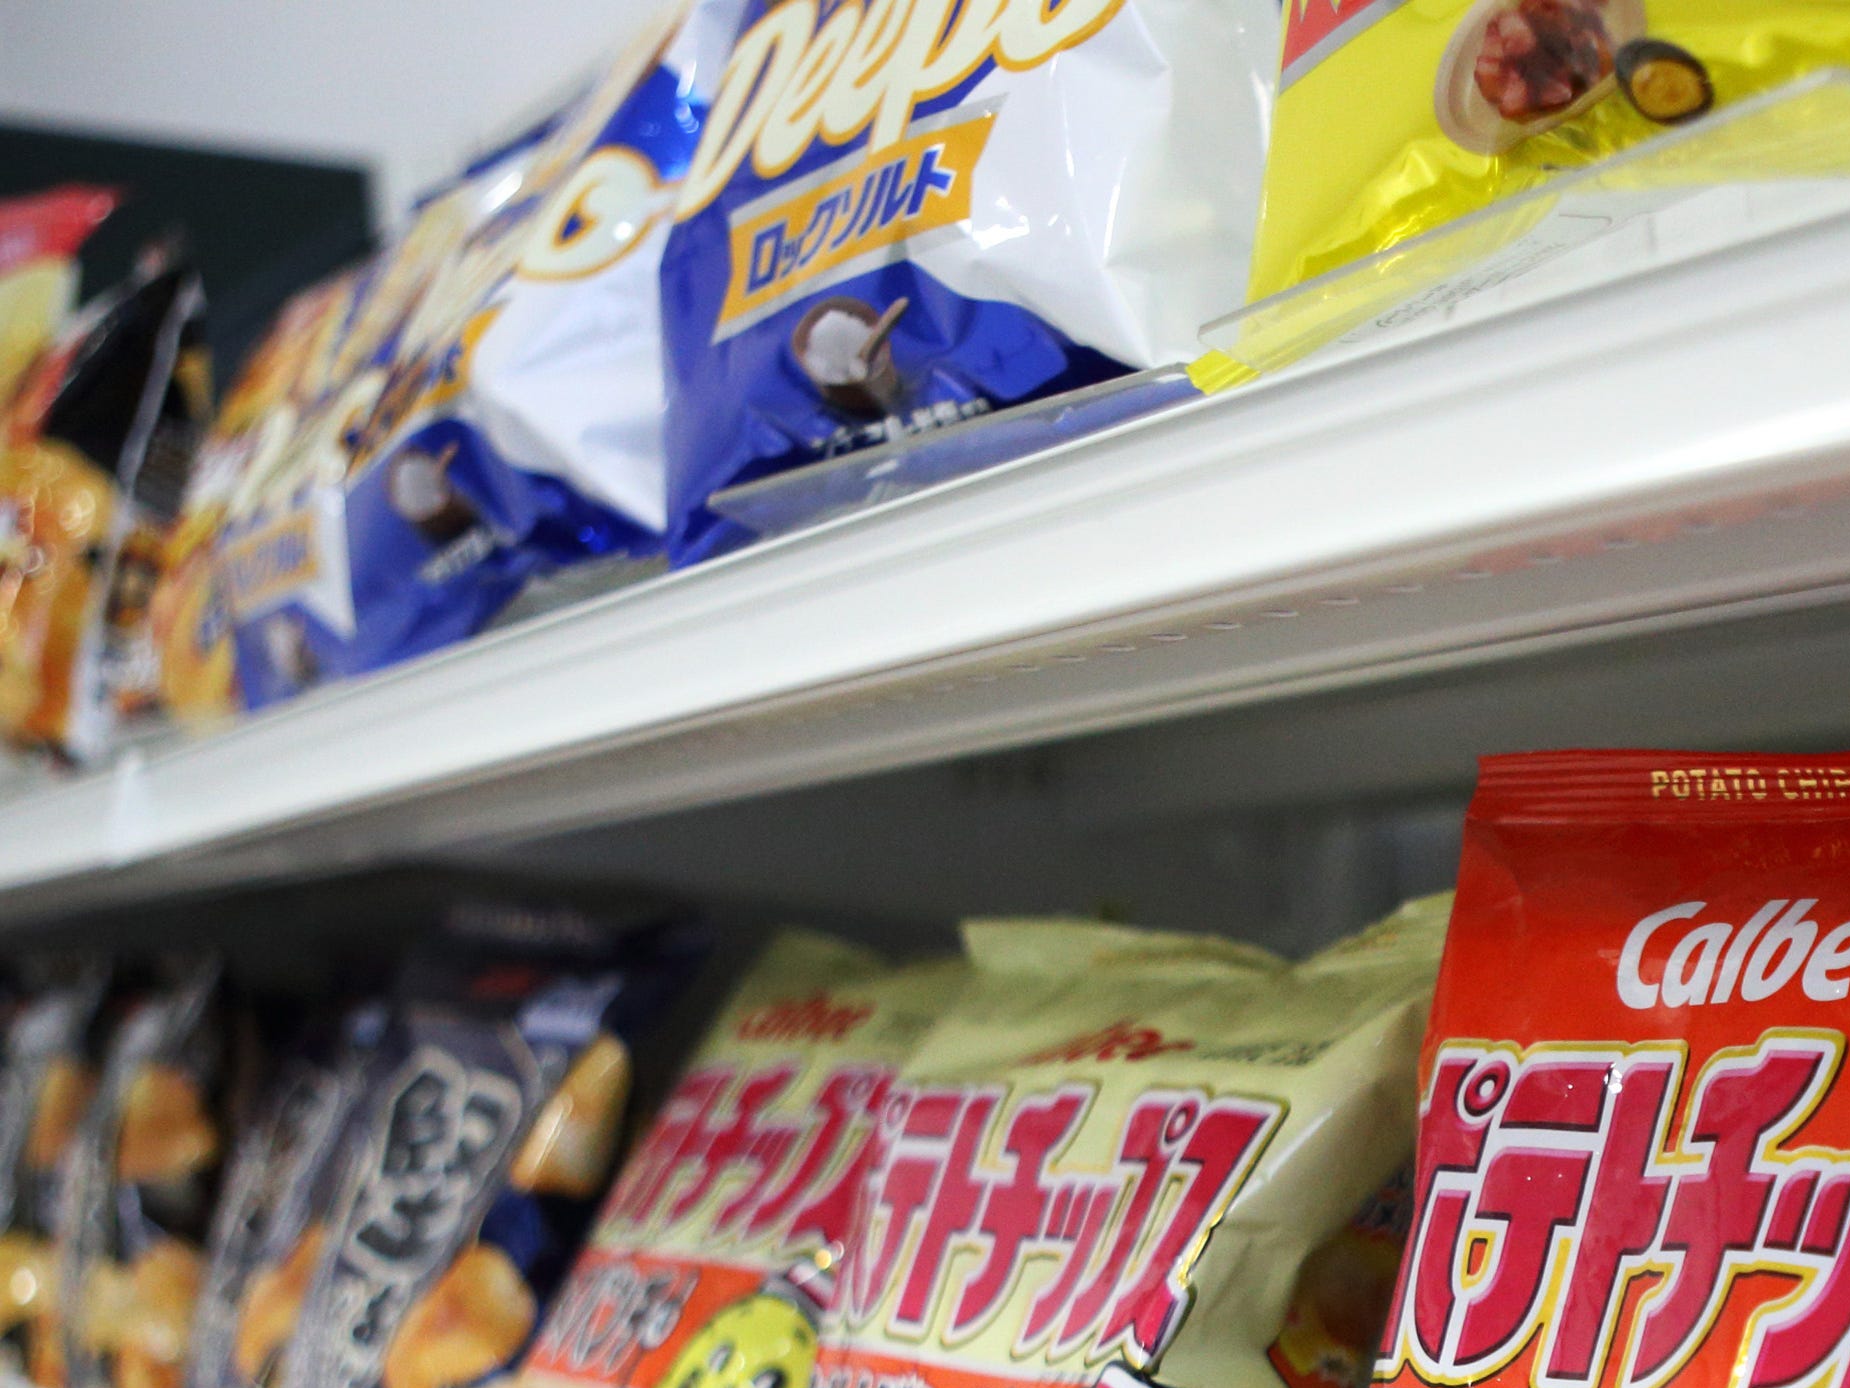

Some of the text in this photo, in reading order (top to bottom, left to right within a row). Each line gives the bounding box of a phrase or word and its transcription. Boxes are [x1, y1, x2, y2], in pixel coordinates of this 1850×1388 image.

[745, 142, 958, 296] ロックソルト
[1650, 768, 1768, 800] POTATO
